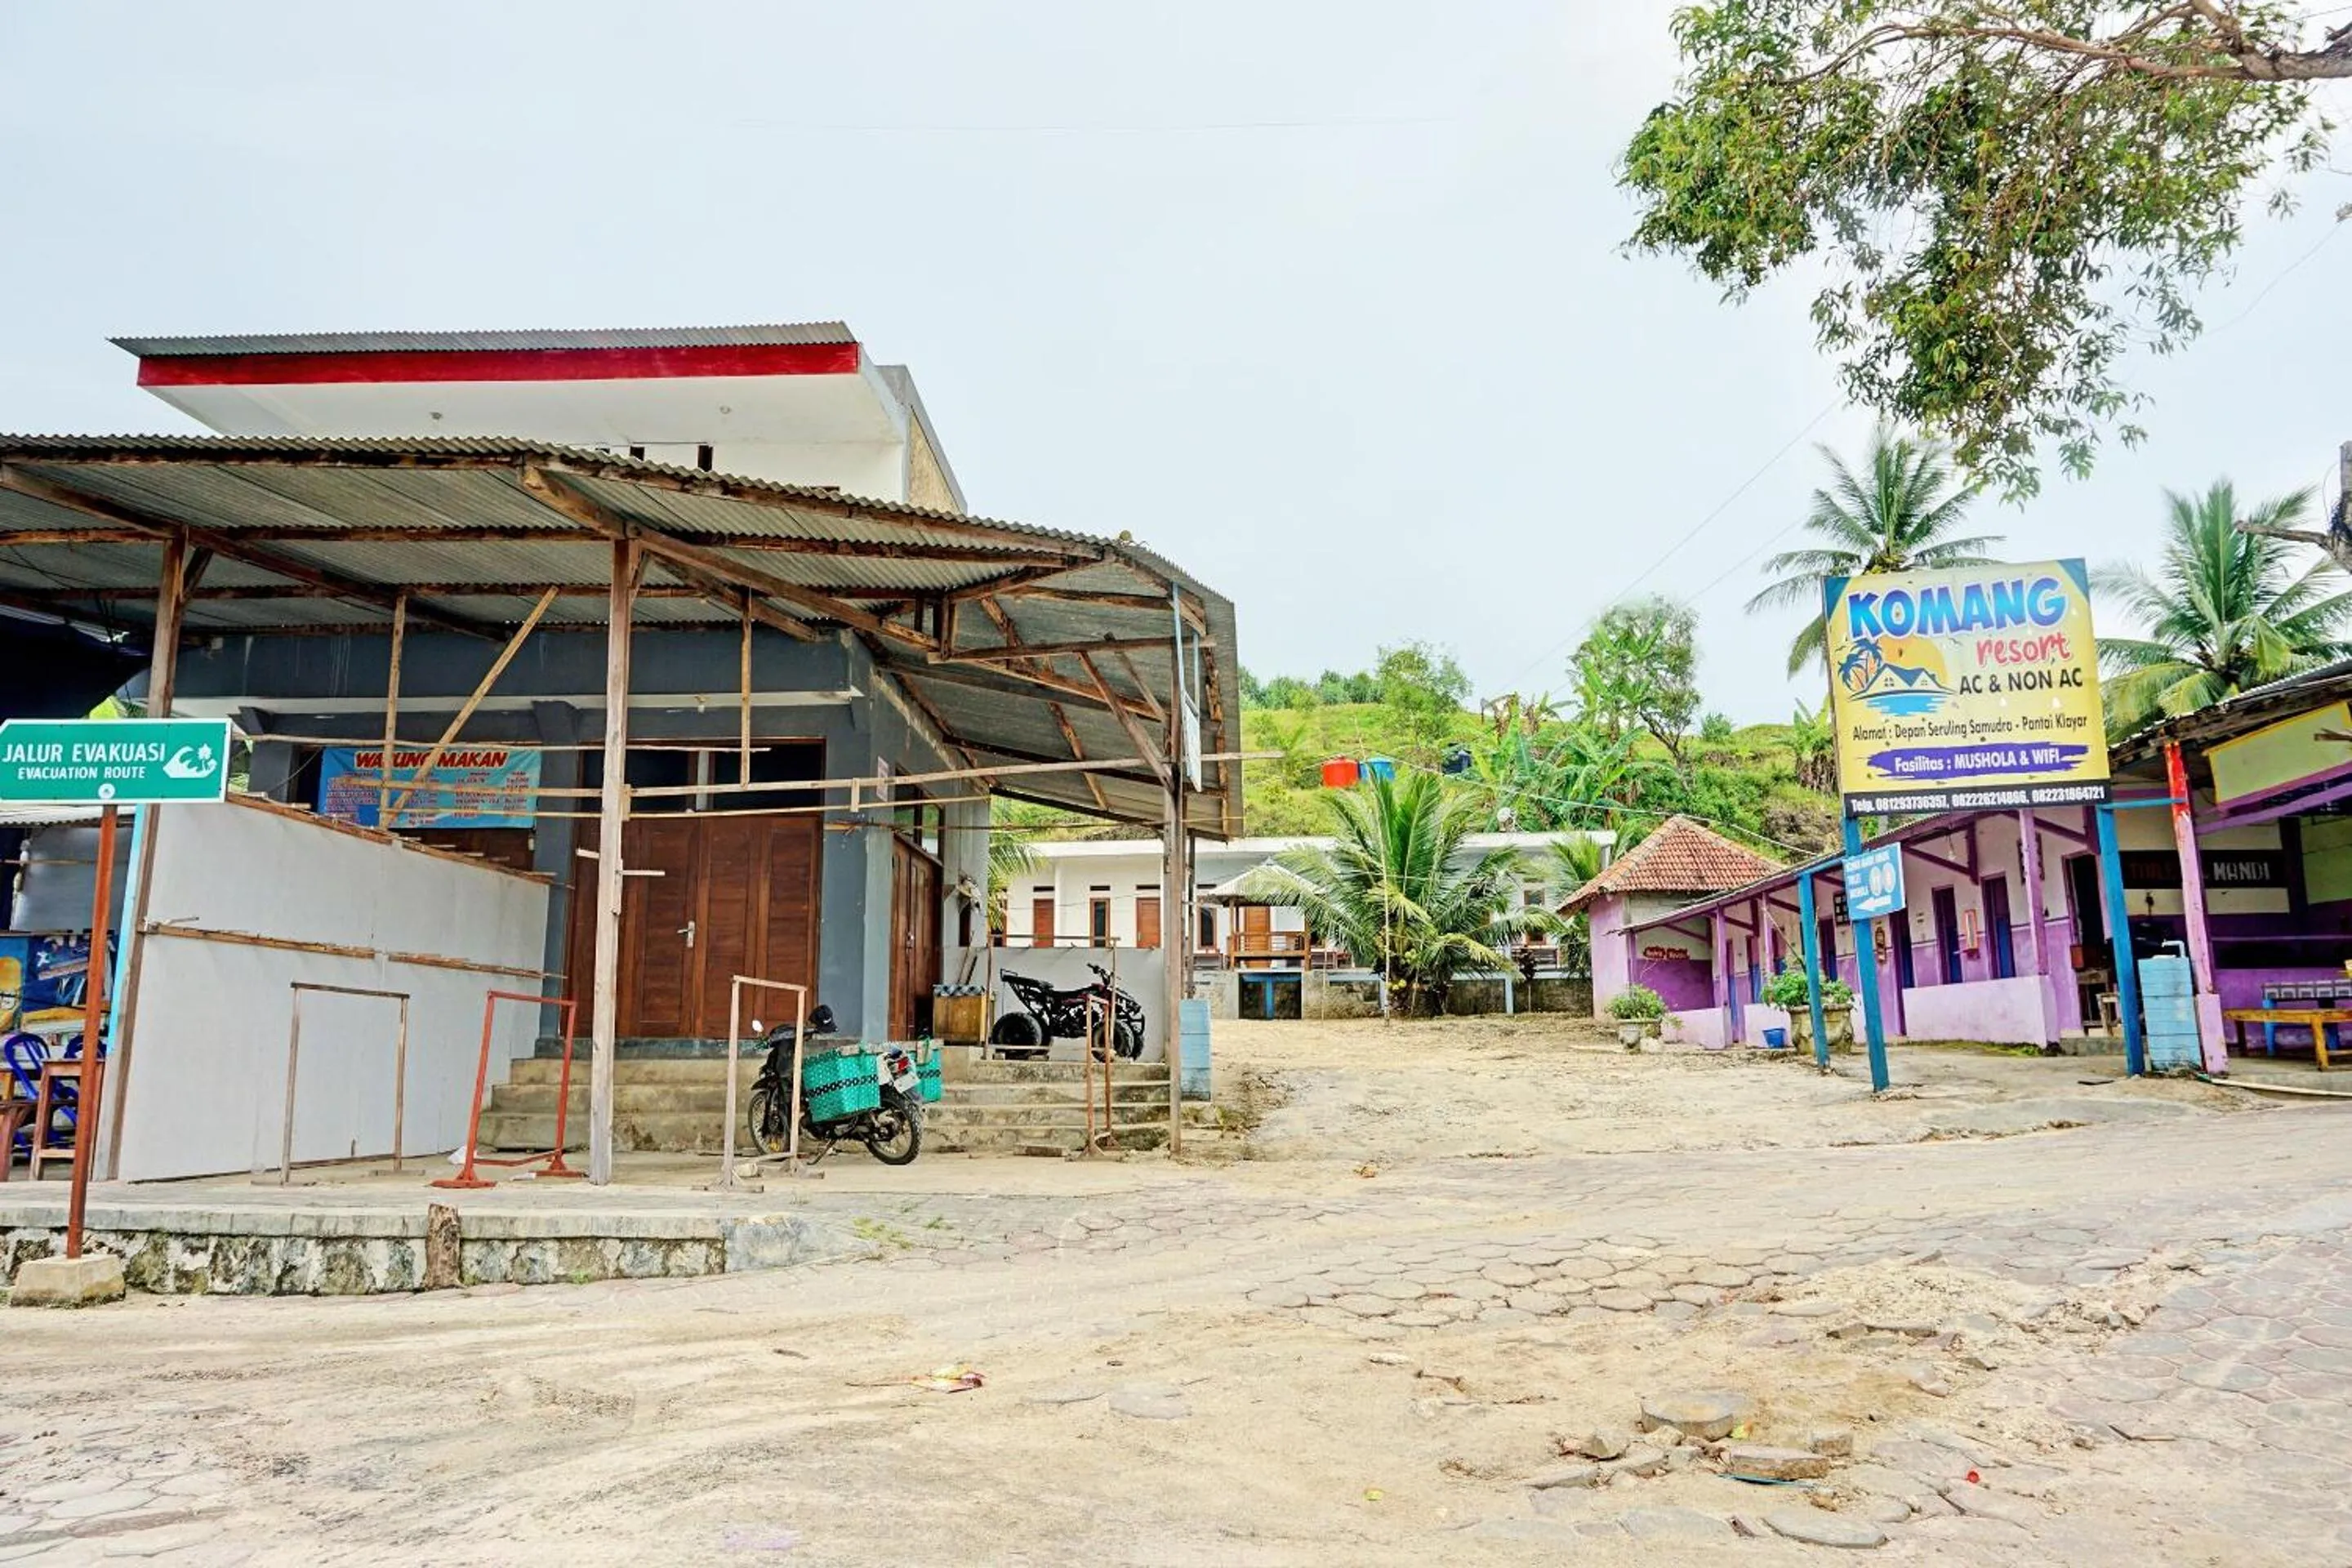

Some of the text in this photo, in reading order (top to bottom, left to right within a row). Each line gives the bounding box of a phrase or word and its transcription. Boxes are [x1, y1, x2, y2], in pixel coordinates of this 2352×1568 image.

[1847, 577, 2067, 639] KOMANG
[1976, 632, 2071, 666] resort
[1960, 667, 2082, 694] AC & NON AC
[1853, 725, 1886, 741] Alamat
[1895, 724, 1926, 742] Depan
[1928, 719, 1967, 738] Seruling
[1969, 716, 2012, 734] Samudra
[2022, 715, 2053, 730] Pantai
[2056, 713, 2087, 732] Klayar
[2, 742, 164, 763] JALUR EVAKUASI
[356, 751, 508, 768] WAUN MAKAN
[1895, 755, 1943, 773] Fasilitas
[1954, 751, 2016, 769] MUSHOLA
[2020, 750, 2029, 765] &
[2032, 748, 2060, 764] WIFI
[18, 766, 145, 780] EVACUATION ROUTE
[2212, 862, 2270, 880] MANDI
